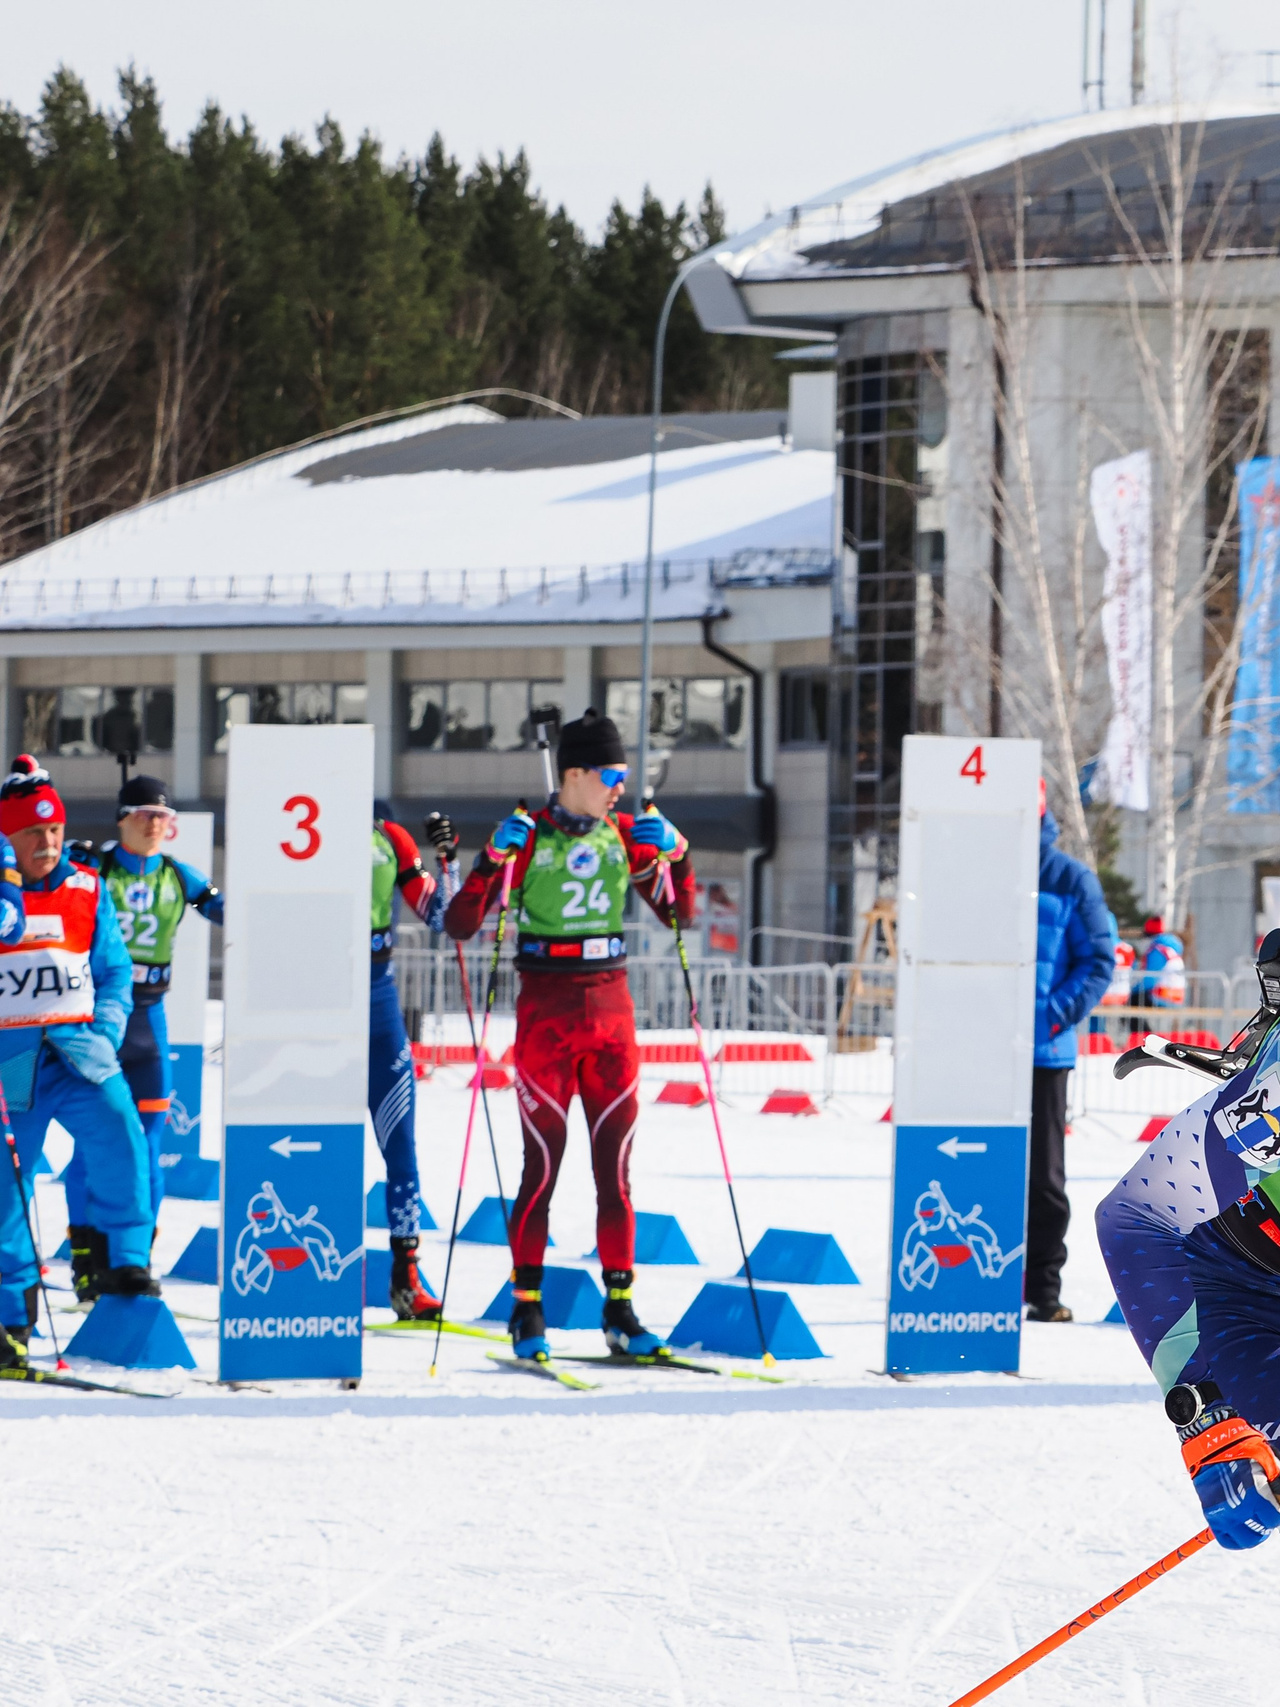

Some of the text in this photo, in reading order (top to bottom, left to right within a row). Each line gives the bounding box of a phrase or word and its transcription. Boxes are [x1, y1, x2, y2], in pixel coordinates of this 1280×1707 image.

[960, 745, 987, 784] 4
[279, 795, 321, 861] 3
[562, 879, 611, 918] 24
[116, 911, 158, 946] 32
[223, 1316, 360, 1339] КРАСНОЯРСК
[890, 1311, 1020, 1333] КРАСНОЯРСК
